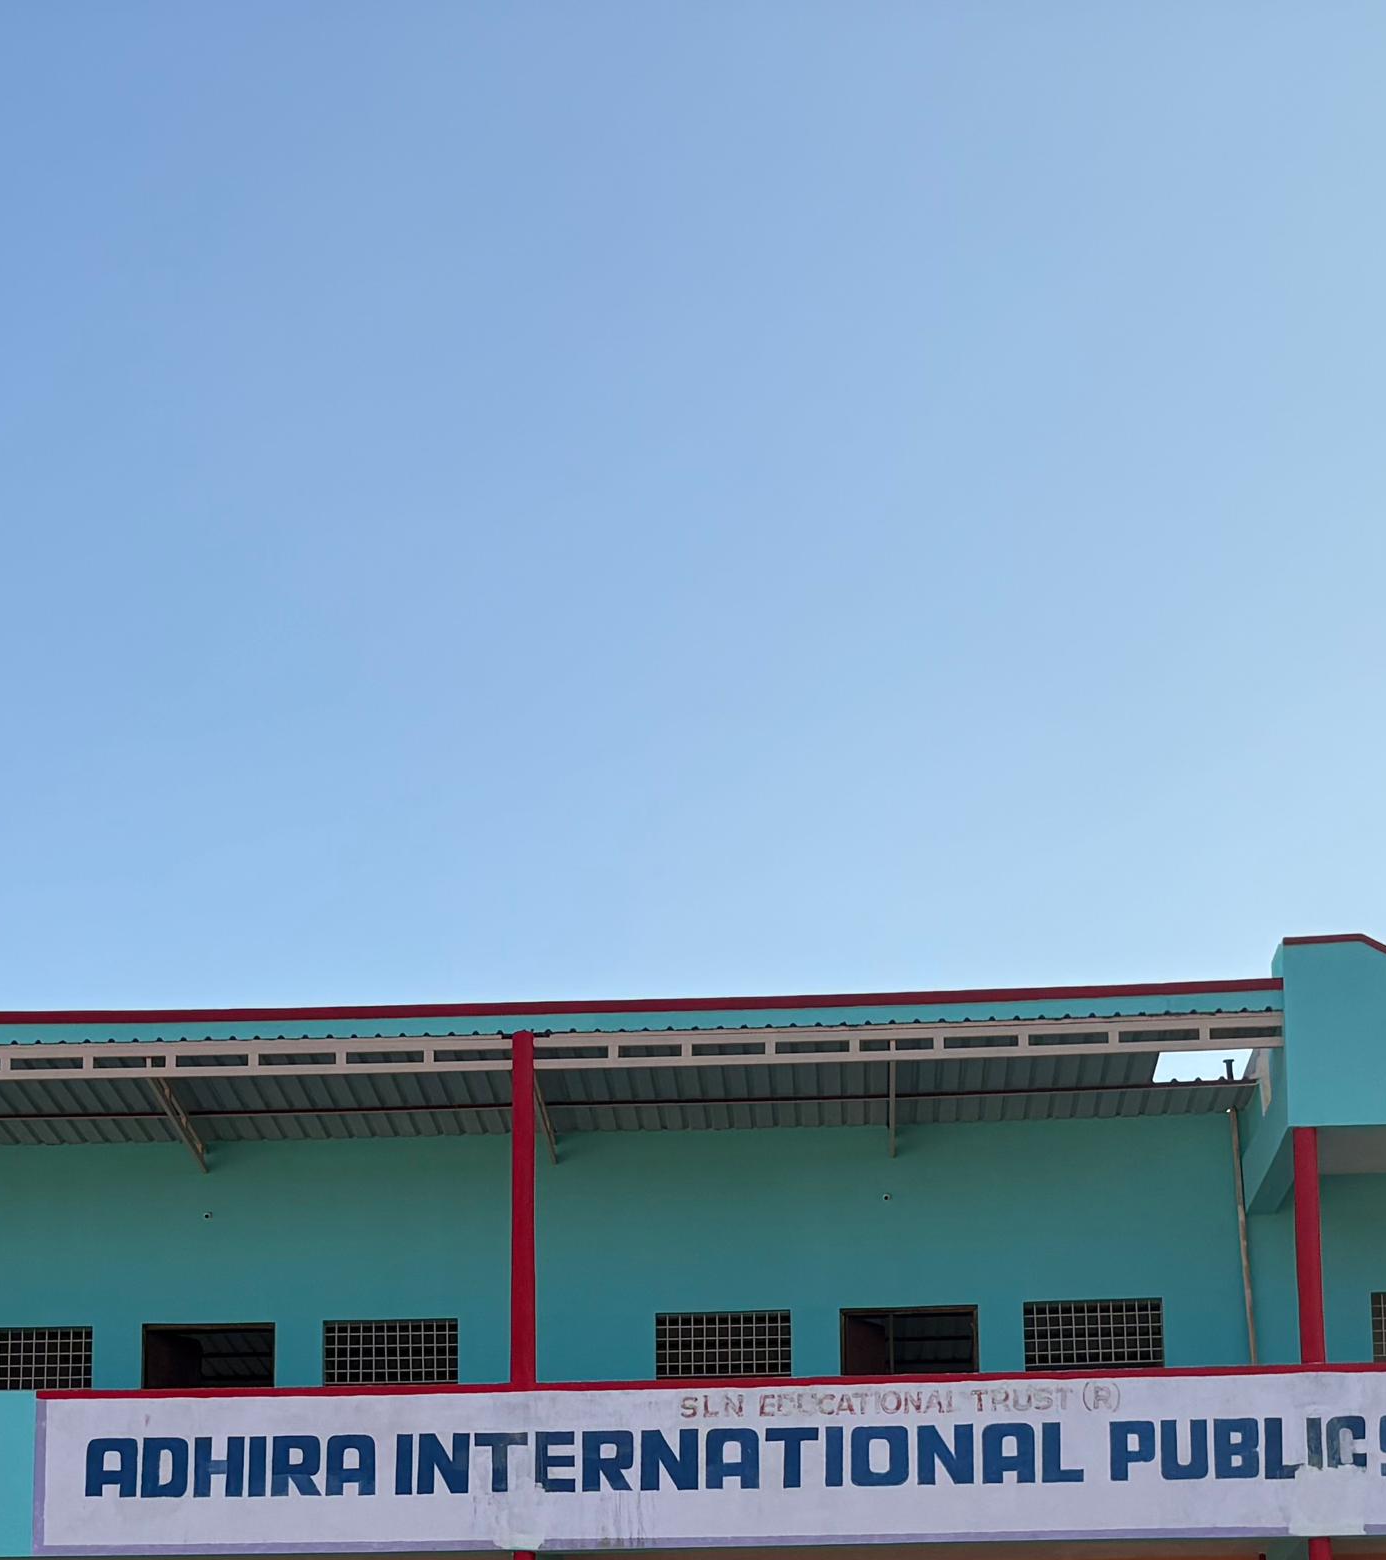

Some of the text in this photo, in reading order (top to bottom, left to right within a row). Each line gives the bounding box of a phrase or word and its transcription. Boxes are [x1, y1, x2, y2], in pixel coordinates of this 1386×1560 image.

[680, 1394, 744, 1418] SLN
[971, 1386, 1073, 1413] TRUST
[84, 1434, 376, 1498] ADHIRA
[394, 1421, 1085, 1495] INTERNATIONAL
[1109, 1415, 1368, 1481] PUBLIC
